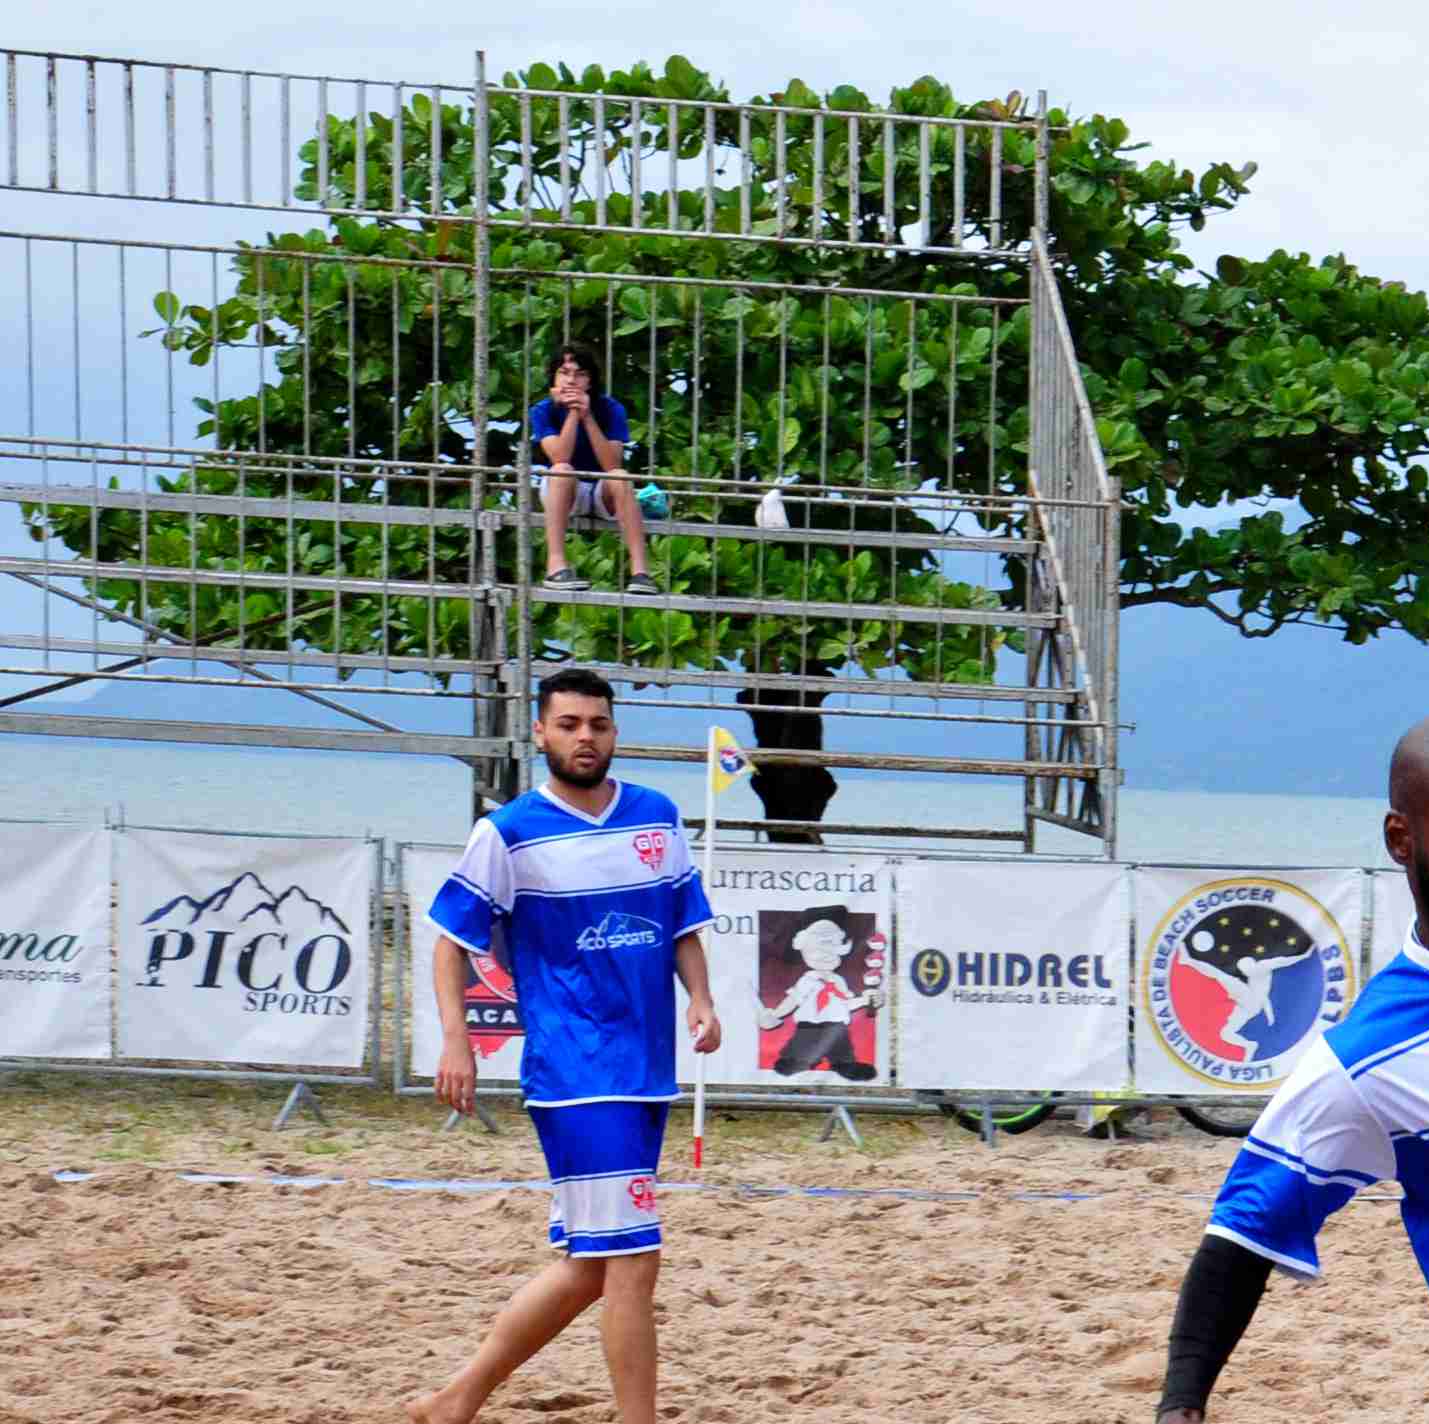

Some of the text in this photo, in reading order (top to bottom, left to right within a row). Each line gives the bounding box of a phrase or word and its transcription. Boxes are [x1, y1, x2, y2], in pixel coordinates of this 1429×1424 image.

[1195, 887, 1277, 913] SOCCER
[1154, 910, 1196, 970] BEACH
[136, 929, 352, 994] PICO
[957, 952, 1112, 989] HIDREL
[243, 991, 353, 1017] SPORTS
[1039, 992, 1051, 1005] &
[1157, 1007, 1224, 1077] PAULISTA
[1227, 1064, 1273, 1081] LIGA
